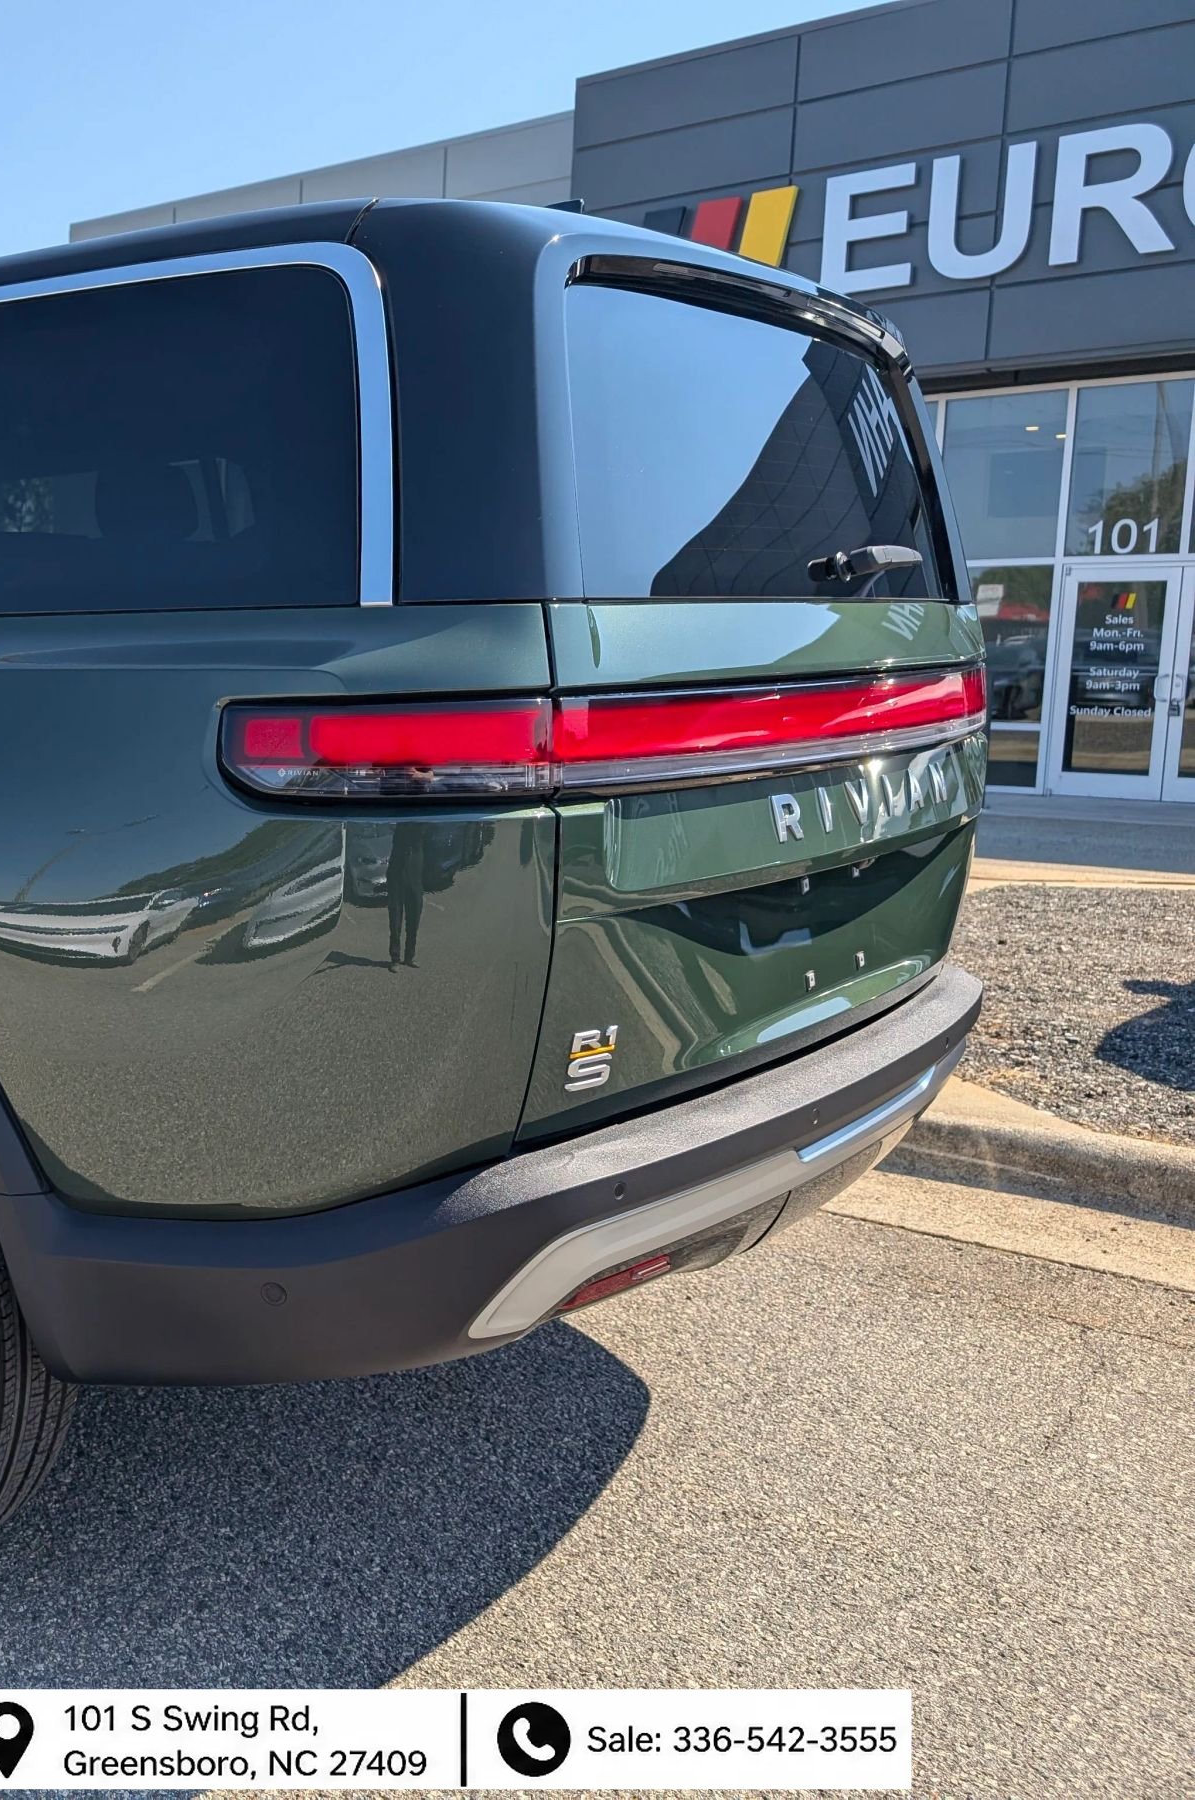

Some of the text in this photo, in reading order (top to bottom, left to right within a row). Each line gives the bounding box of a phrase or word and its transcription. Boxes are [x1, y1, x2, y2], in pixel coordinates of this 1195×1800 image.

[819, 122, 1195, 294] EUR
[1088, 518, 1159, 555] 101
[1105, 614, 1134, 625] Sales
[1093, 627, 1144, 638] Mon.-Fri.
[1089, 641, 1144, 653] 9am-6pm
[1089, 667, 1139, 679] Saturday
[1085, 680, 1140, 692] 9am-3pm
[1069, 705, 1152, 717] Sunday Closed
[287, 769, 319, 777] RIVIAN
[769, 761, 948, 843] RIVIAN
[571, 1025, 618, 1053] R1
[564, 1052, 612, 1092] S
